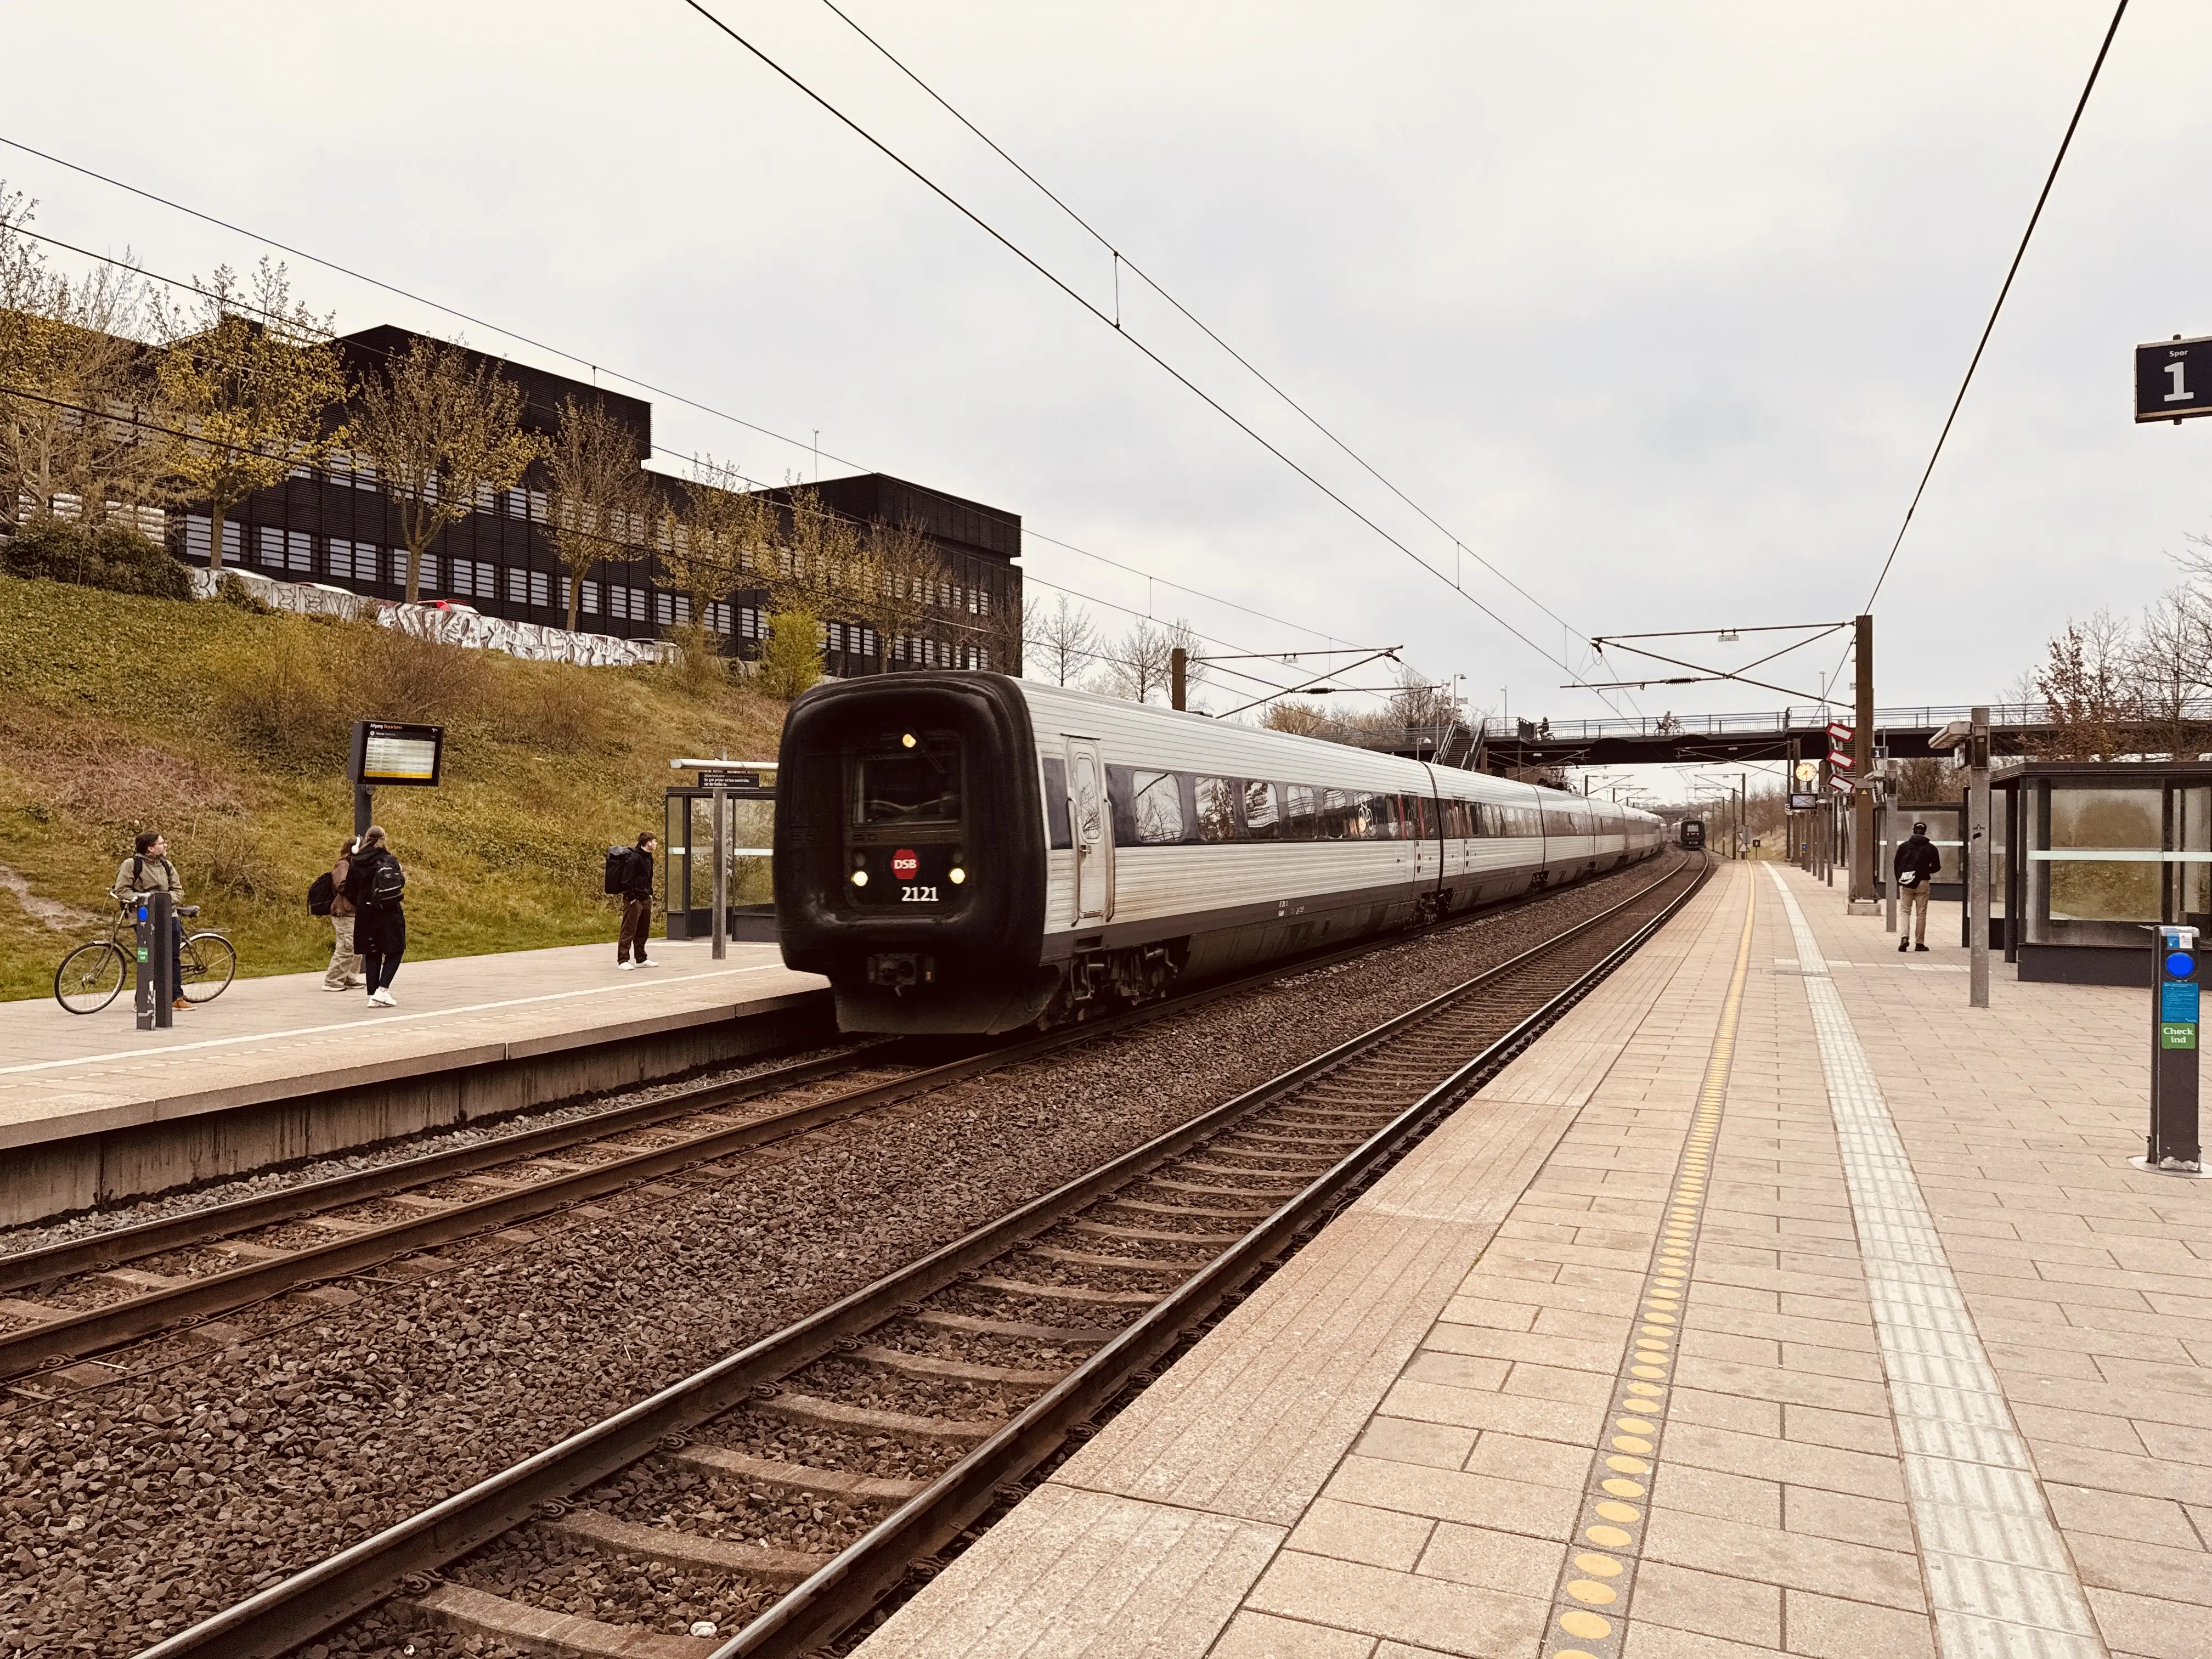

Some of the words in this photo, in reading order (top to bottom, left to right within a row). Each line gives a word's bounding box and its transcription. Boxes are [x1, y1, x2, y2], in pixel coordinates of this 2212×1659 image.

[2164, 362, 2194, 402] 1
[894, 859, 917, 869] DSB
[901, 887, 939, 901] 2121
